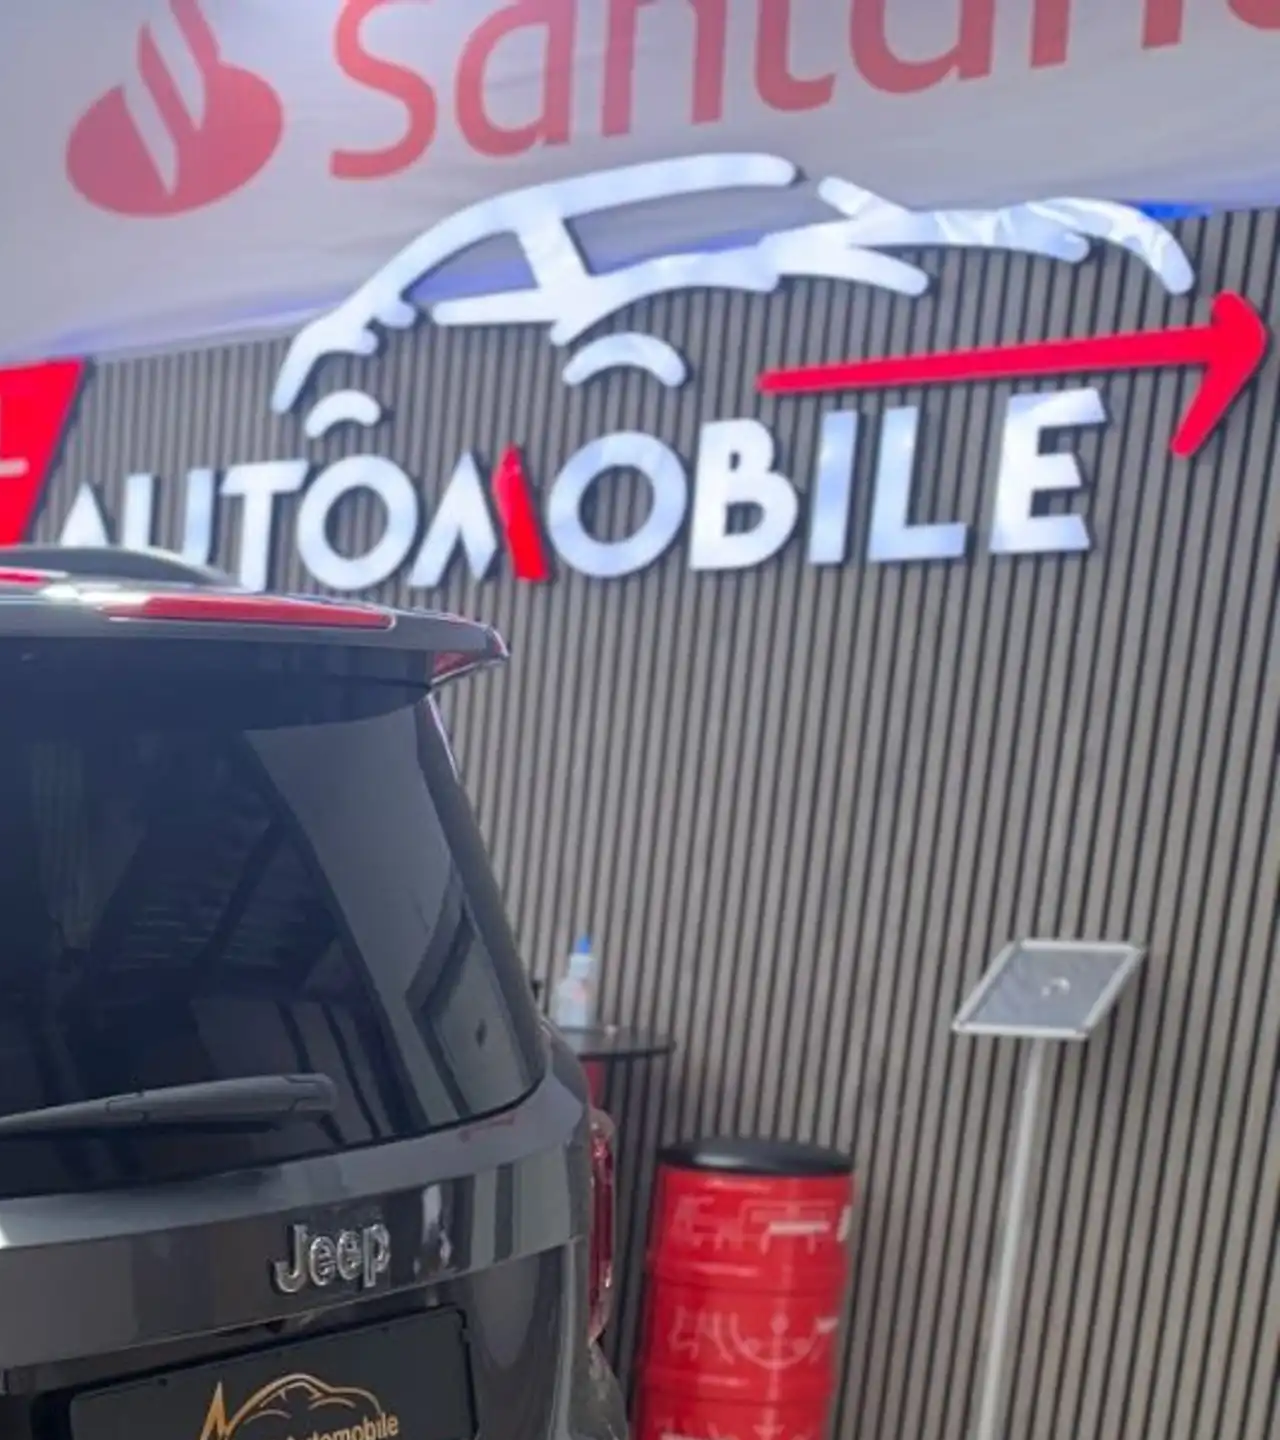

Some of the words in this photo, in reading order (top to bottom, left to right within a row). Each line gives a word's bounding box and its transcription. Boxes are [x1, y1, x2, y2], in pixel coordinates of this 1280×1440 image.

[329, 0, 1280, 180] Santa
[58, 388, 1108, 593] AUTOMOBILE
[274, 1223, 391, 1292] Jeep
